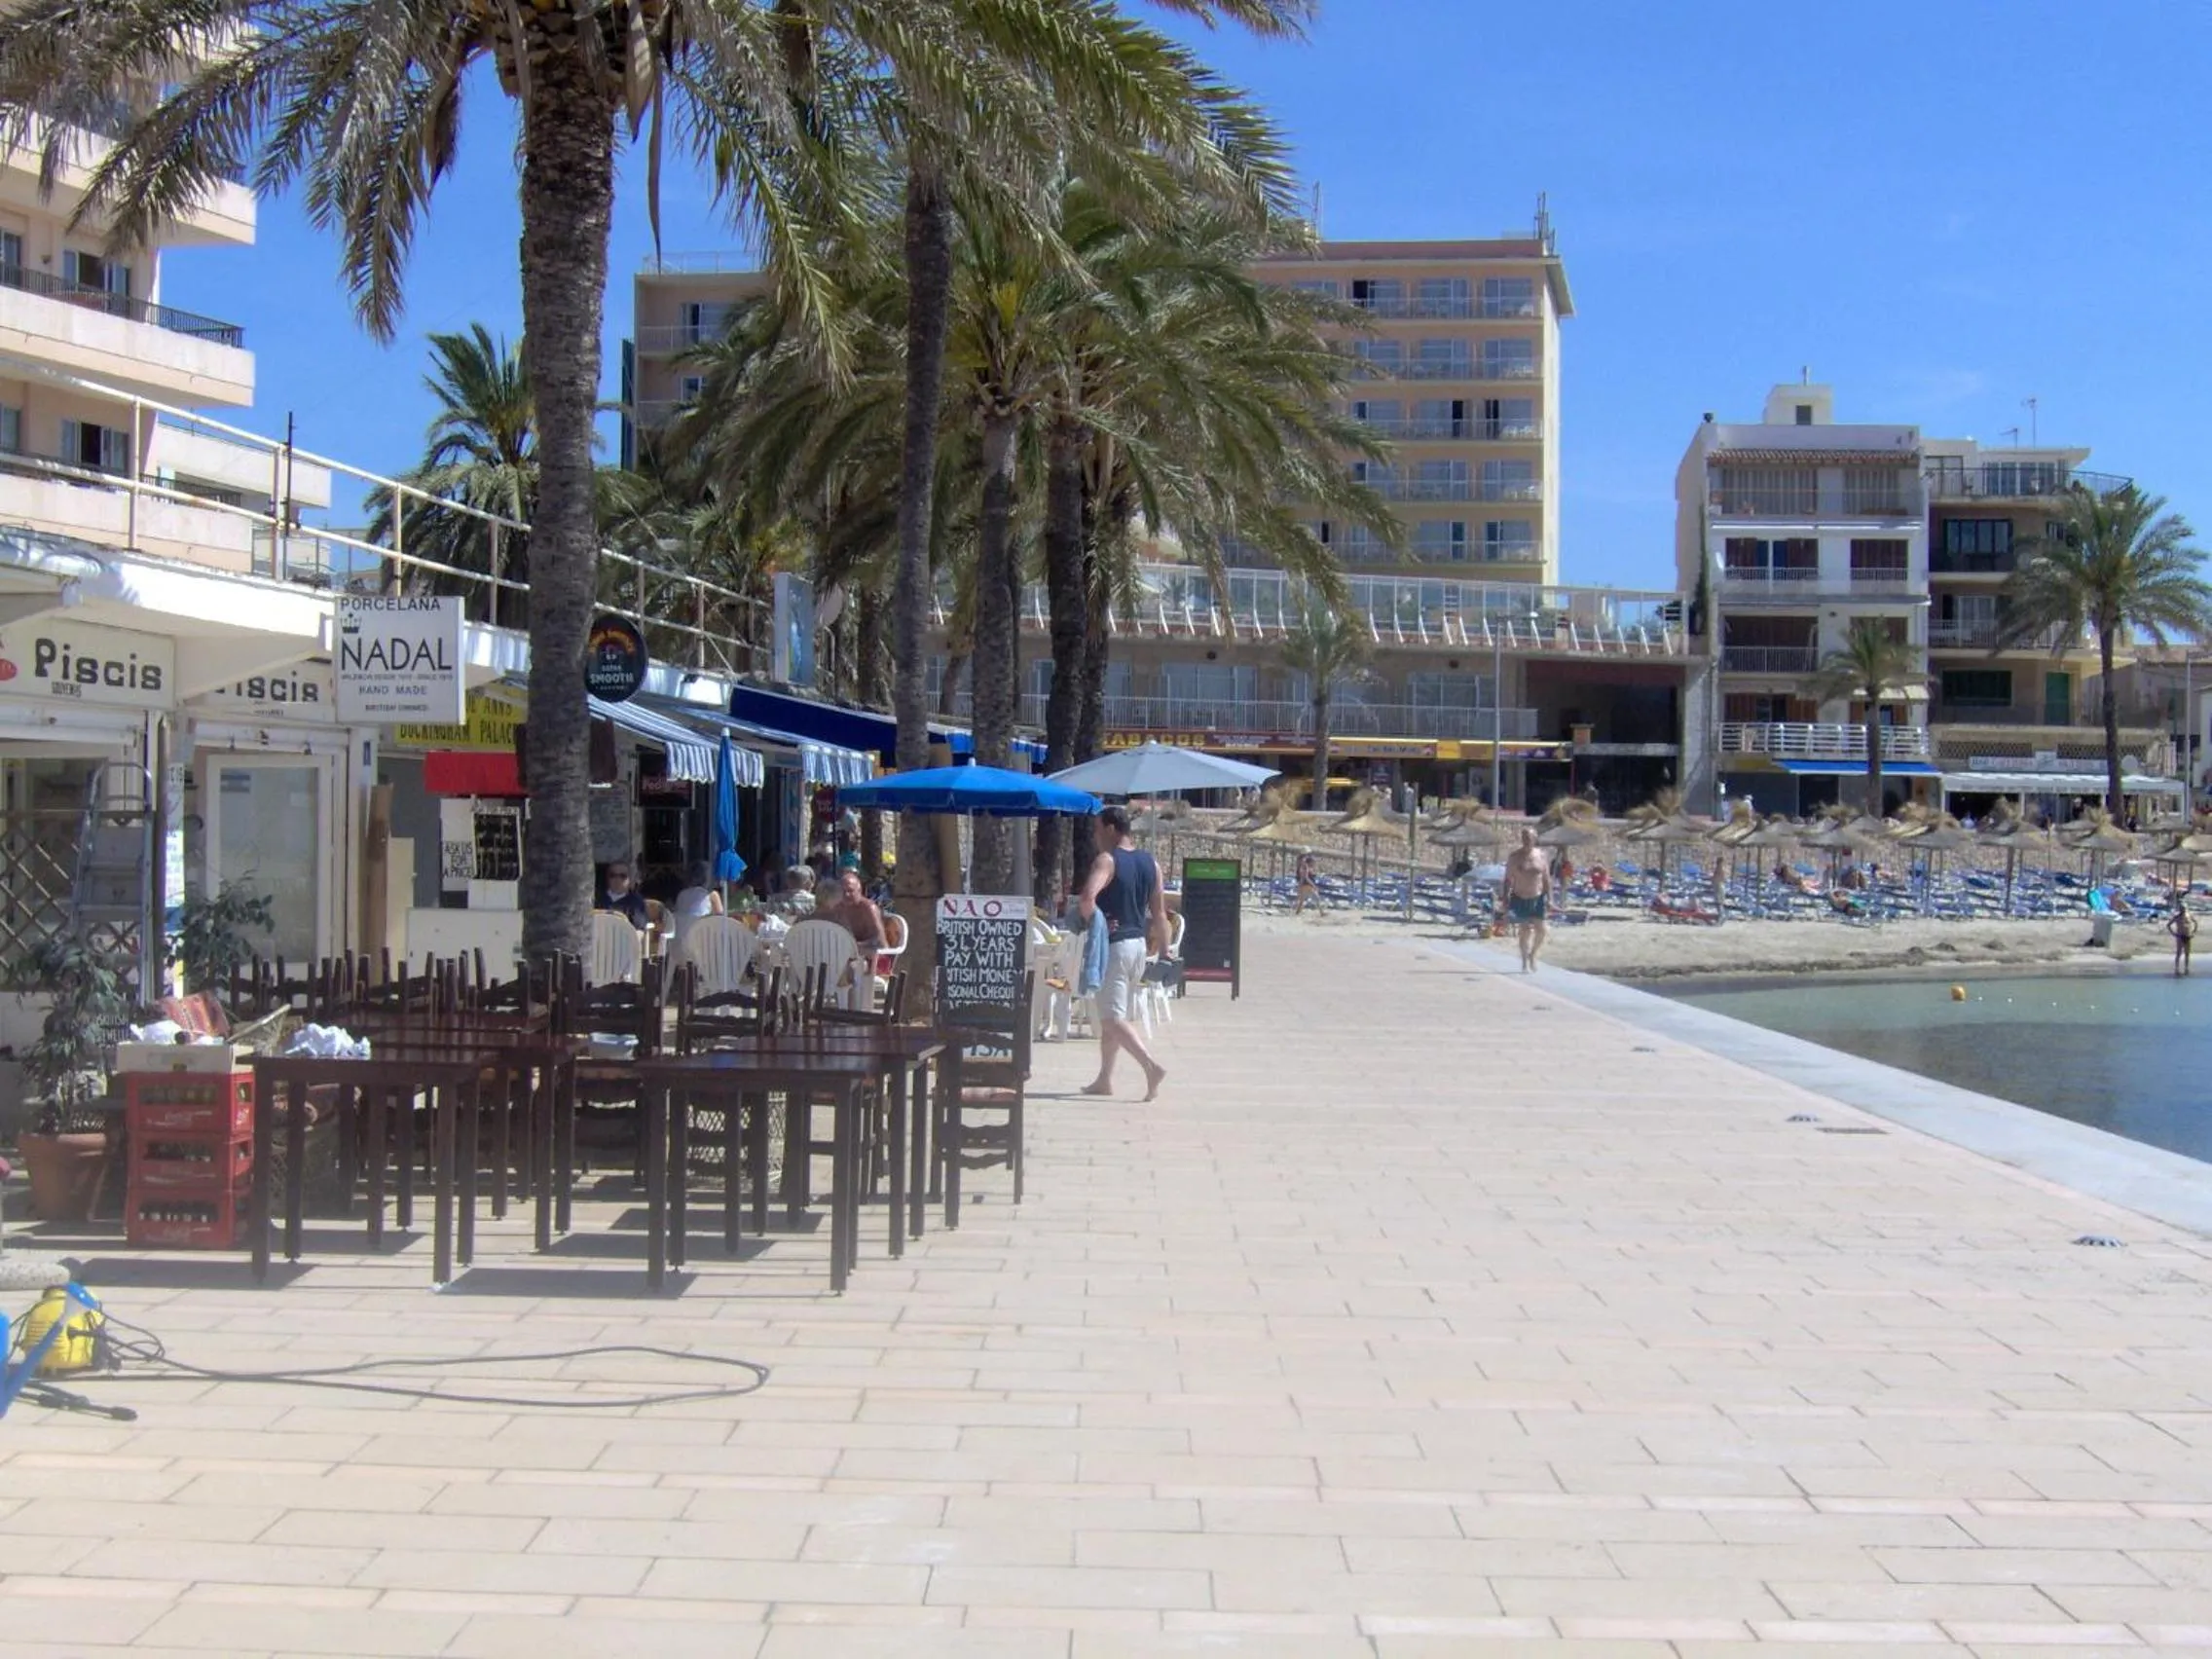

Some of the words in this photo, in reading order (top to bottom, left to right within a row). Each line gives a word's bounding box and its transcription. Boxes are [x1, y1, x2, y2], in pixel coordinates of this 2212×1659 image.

[340, 597, 441, 611] PORCELANA
[341, 637, 453, 671] NADAL
[35, 638, 162, 690] Piscis
[358, 684, 389, 695] HAND
[395, 684, 427, 695] MADE
[944, 899, 1002, 917] NAO
[937, 919, 976, 935] BRITISH
[977, 919, 1022, 936] OWNED
[972, 936, 1015, 952] YEARS
[944, 950, 971, 967] PAY
[975, 950, 1014, 968] WITH
